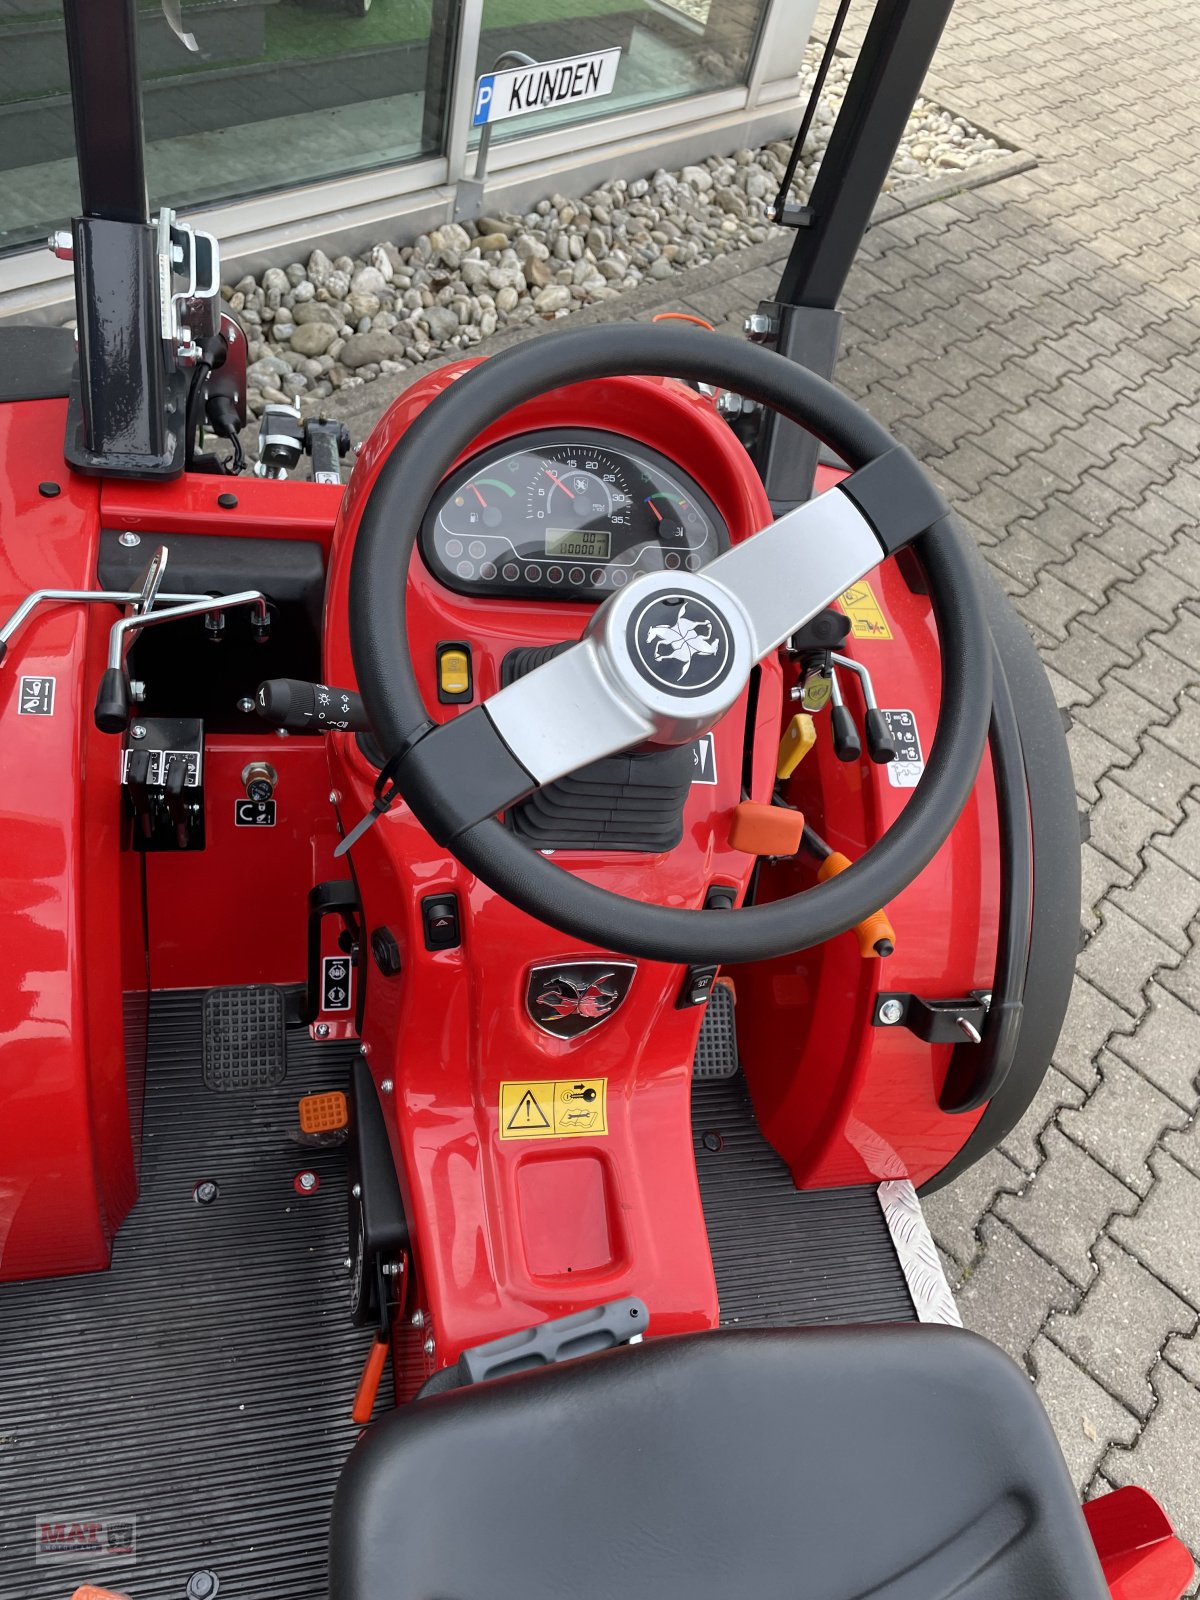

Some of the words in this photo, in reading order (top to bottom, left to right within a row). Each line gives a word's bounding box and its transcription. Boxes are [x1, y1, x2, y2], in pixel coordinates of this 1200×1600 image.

[475, 86, 492, 116] P
[508, 59, 603, 112] KUNDEN
[566, 459, 578, 468] 15
[585, 461, 599, 470] 20
[602, 474, 616, 482] 25
[538, 488, 545, 496] 5
[612, 493, 625, 502] 30
[537, 510, 545, 519] 0
[611, 515, 624, 524] 35
